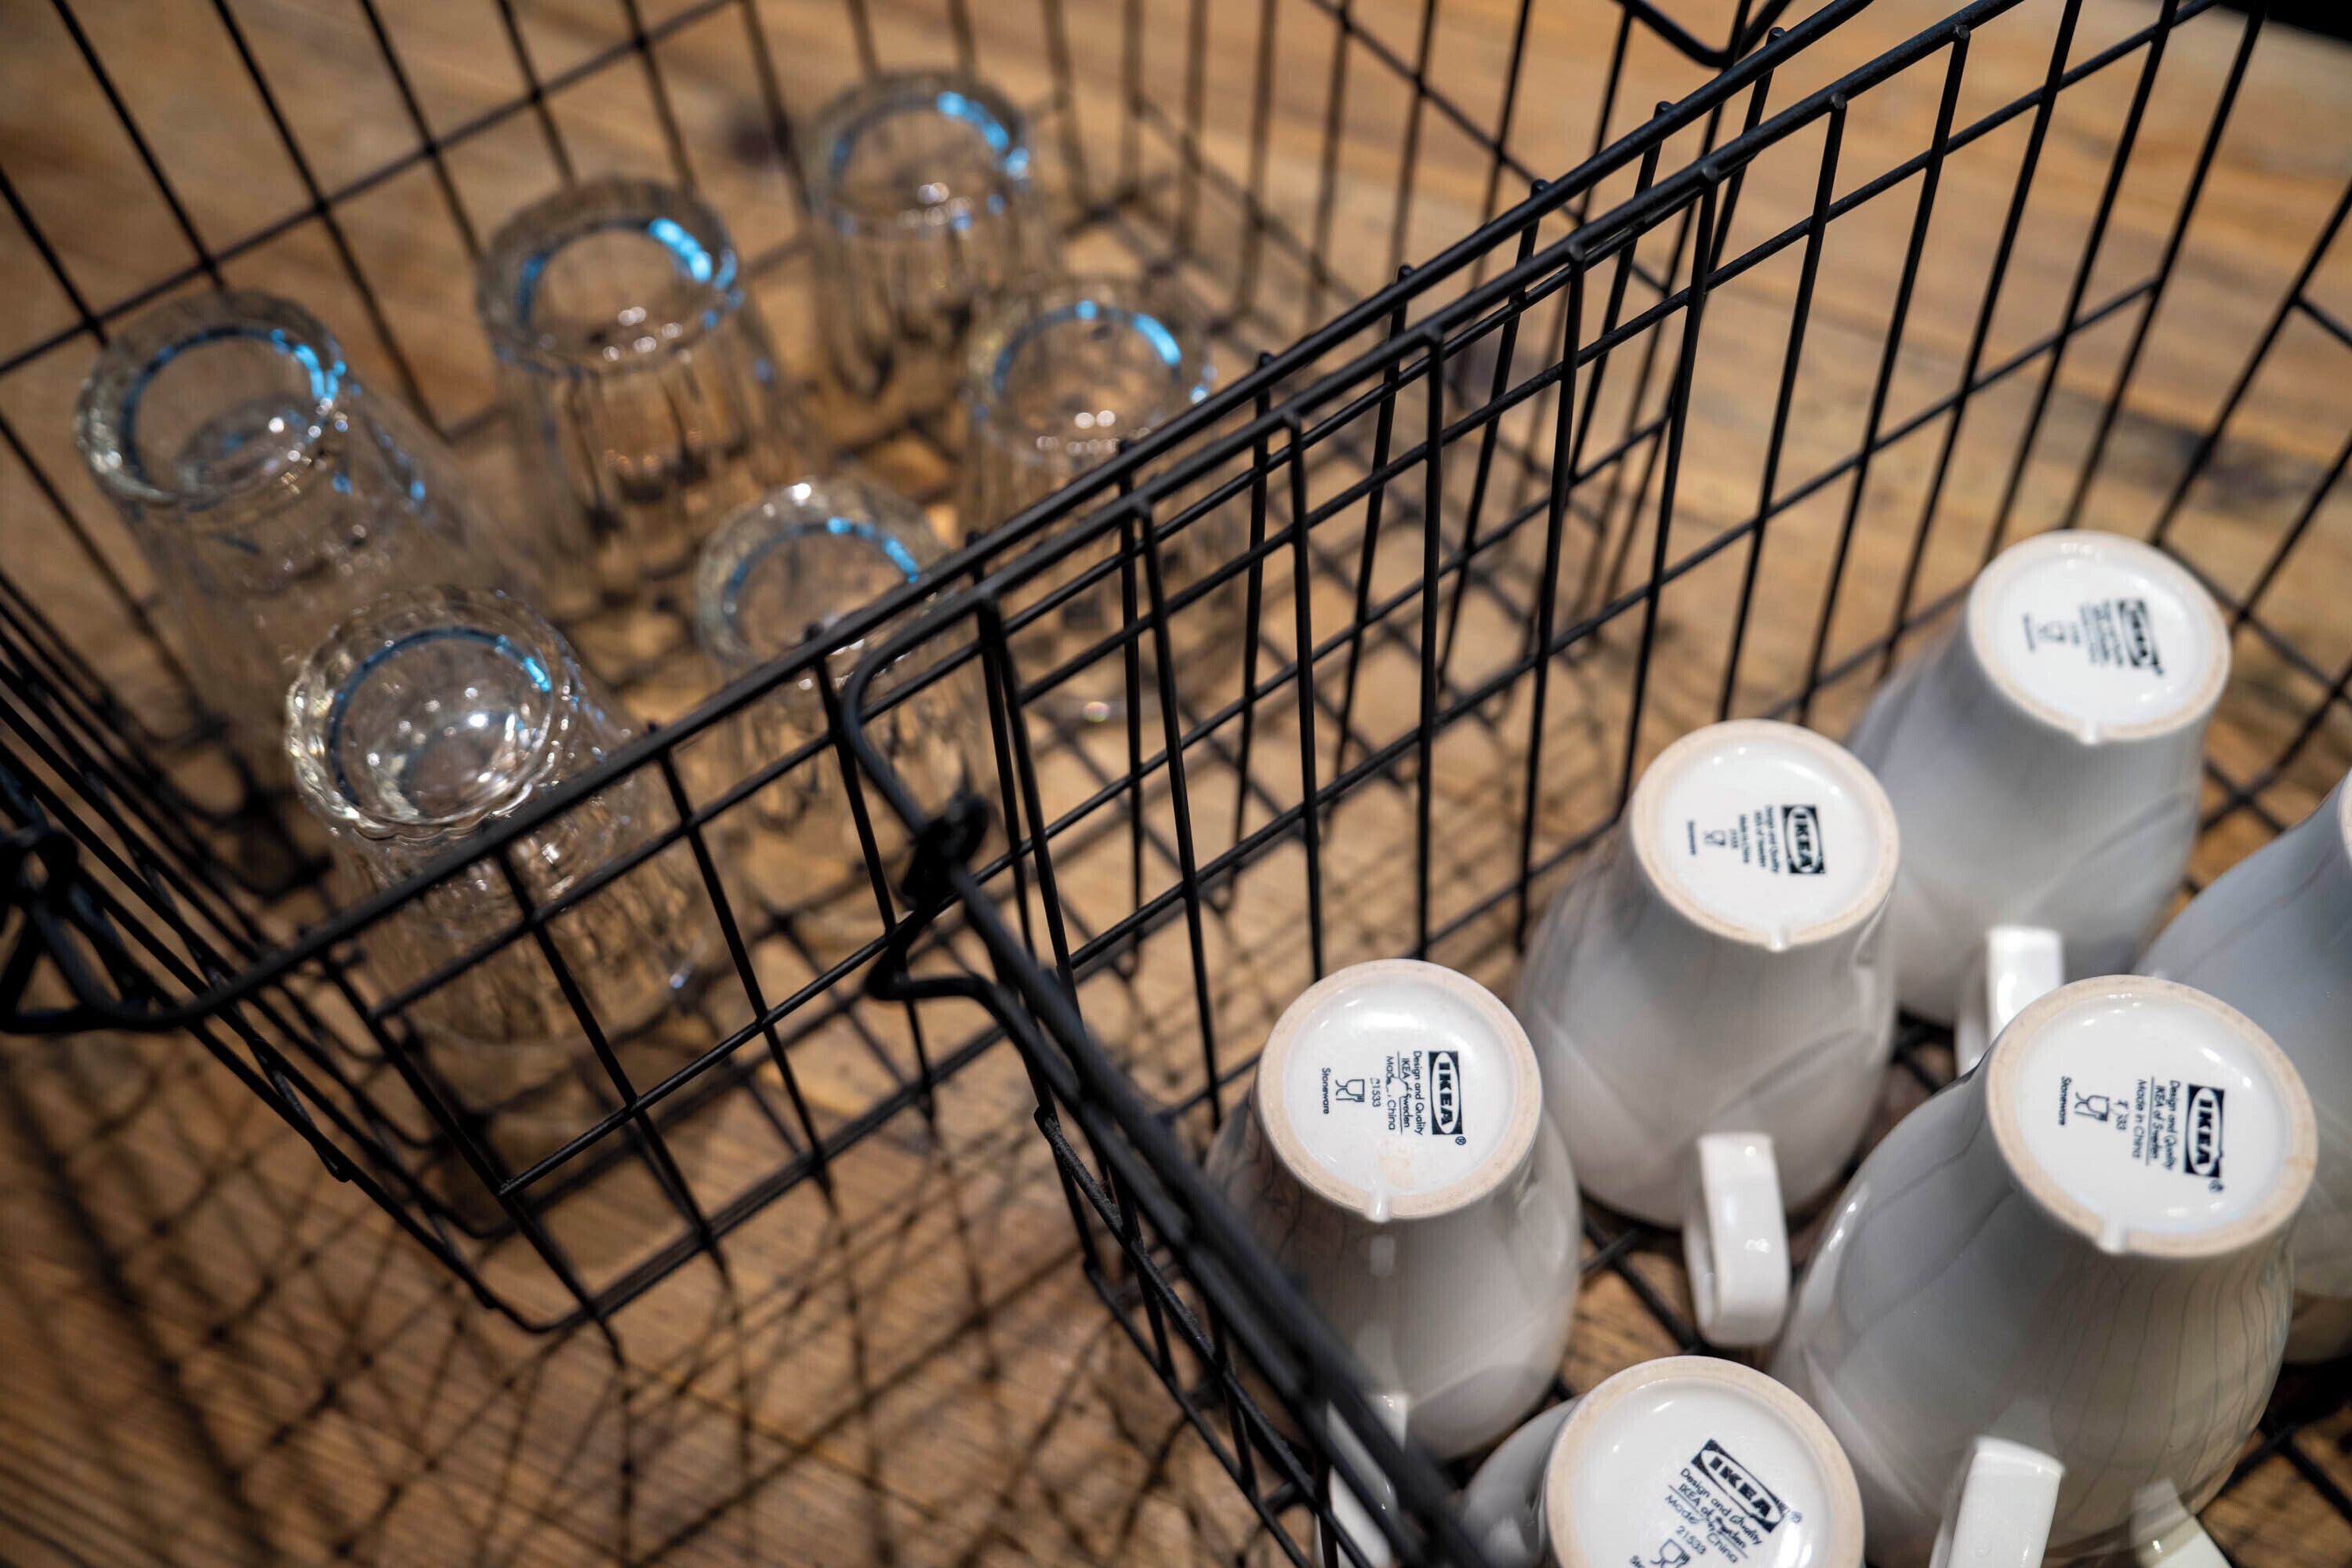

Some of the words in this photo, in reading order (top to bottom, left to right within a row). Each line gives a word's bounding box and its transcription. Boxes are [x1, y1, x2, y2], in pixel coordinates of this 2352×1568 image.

[1793, 814, 1813, 868] IKEA
[1402, 1058, 1411, 1079] IKEA
[1411, 1051, 1422, 1080] Design
[1321, 1067, 1331, 1115] Stoneware
[1414, 1083, 1425, 1100] and
[1438, 1062, 1454, 1126] IKEA
[2058, 1076, 2072, 1126] Stoneware
[2135, 1079, 2147, 1112] Made
[2155, 1085, 2165, 1107] IKEA
[2166, 1080, 2181, 1112] Design
[1387, 1100, 1397, 1131] China
[1414, 1102, 1427, 1136] Quality
[2135, 1114, 2143, 1123] in
[2153, 1109, 2164, 1122] of
[2167, 1114, 2177, 1134] and
[2194, 1098, 2212, 1165] IKEA
[2131, 1126, 2145, 1159] China
[1679, 1483, 1701, 1507] IKEA
[1700, 1507, 1714, 1521] of
[1680, 1468, 1711, 1498] Design
[1711, 1498, 1732, 1517] and
[1709, 1456, 1772, 1518] IKEA
[1664, 1494, 1700, 1524] Made
[1706, 1532, 1739, 1564] China
[1675, 1525, 1707, 1555] 21533
